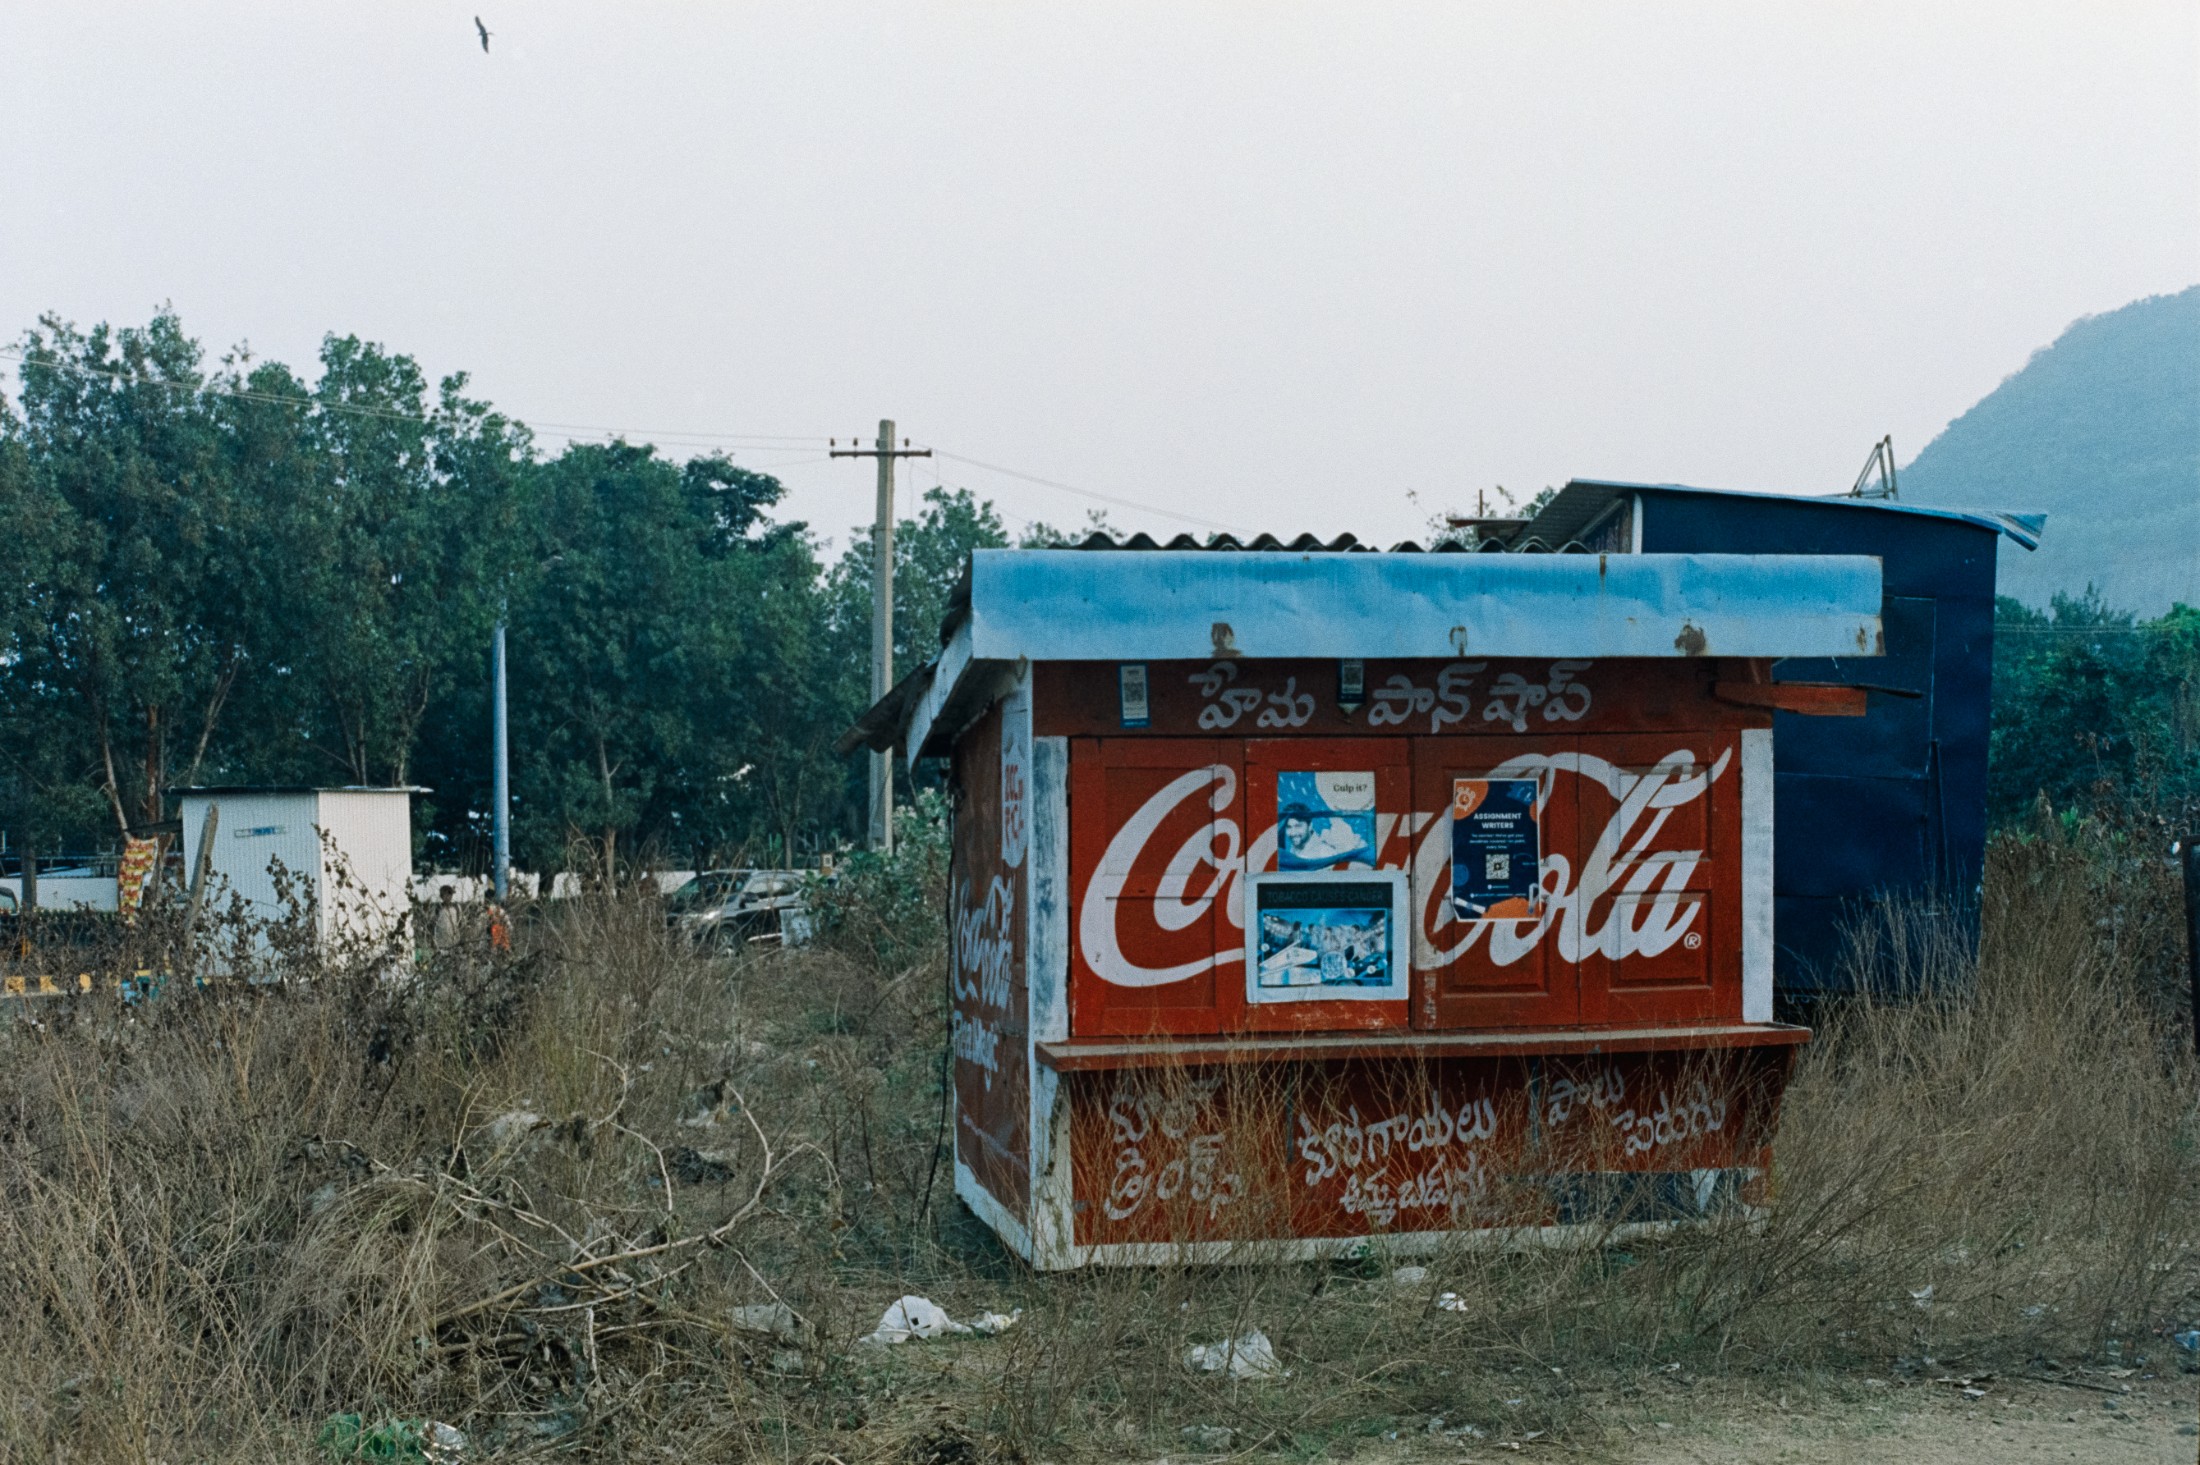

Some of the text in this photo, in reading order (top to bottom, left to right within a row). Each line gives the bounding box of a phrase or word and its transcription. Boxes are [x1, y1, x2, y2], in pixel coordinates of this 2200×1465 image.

[1188, 659, 1593, 734] హేమ పాన్ షాప్
[1473, 812, 1522, 820] ASSIGNMENT
[1481, 821, 1514, 829] WRITERS
[1267, 890, 1384, 903] TOBACCO CAUSES CANCER
